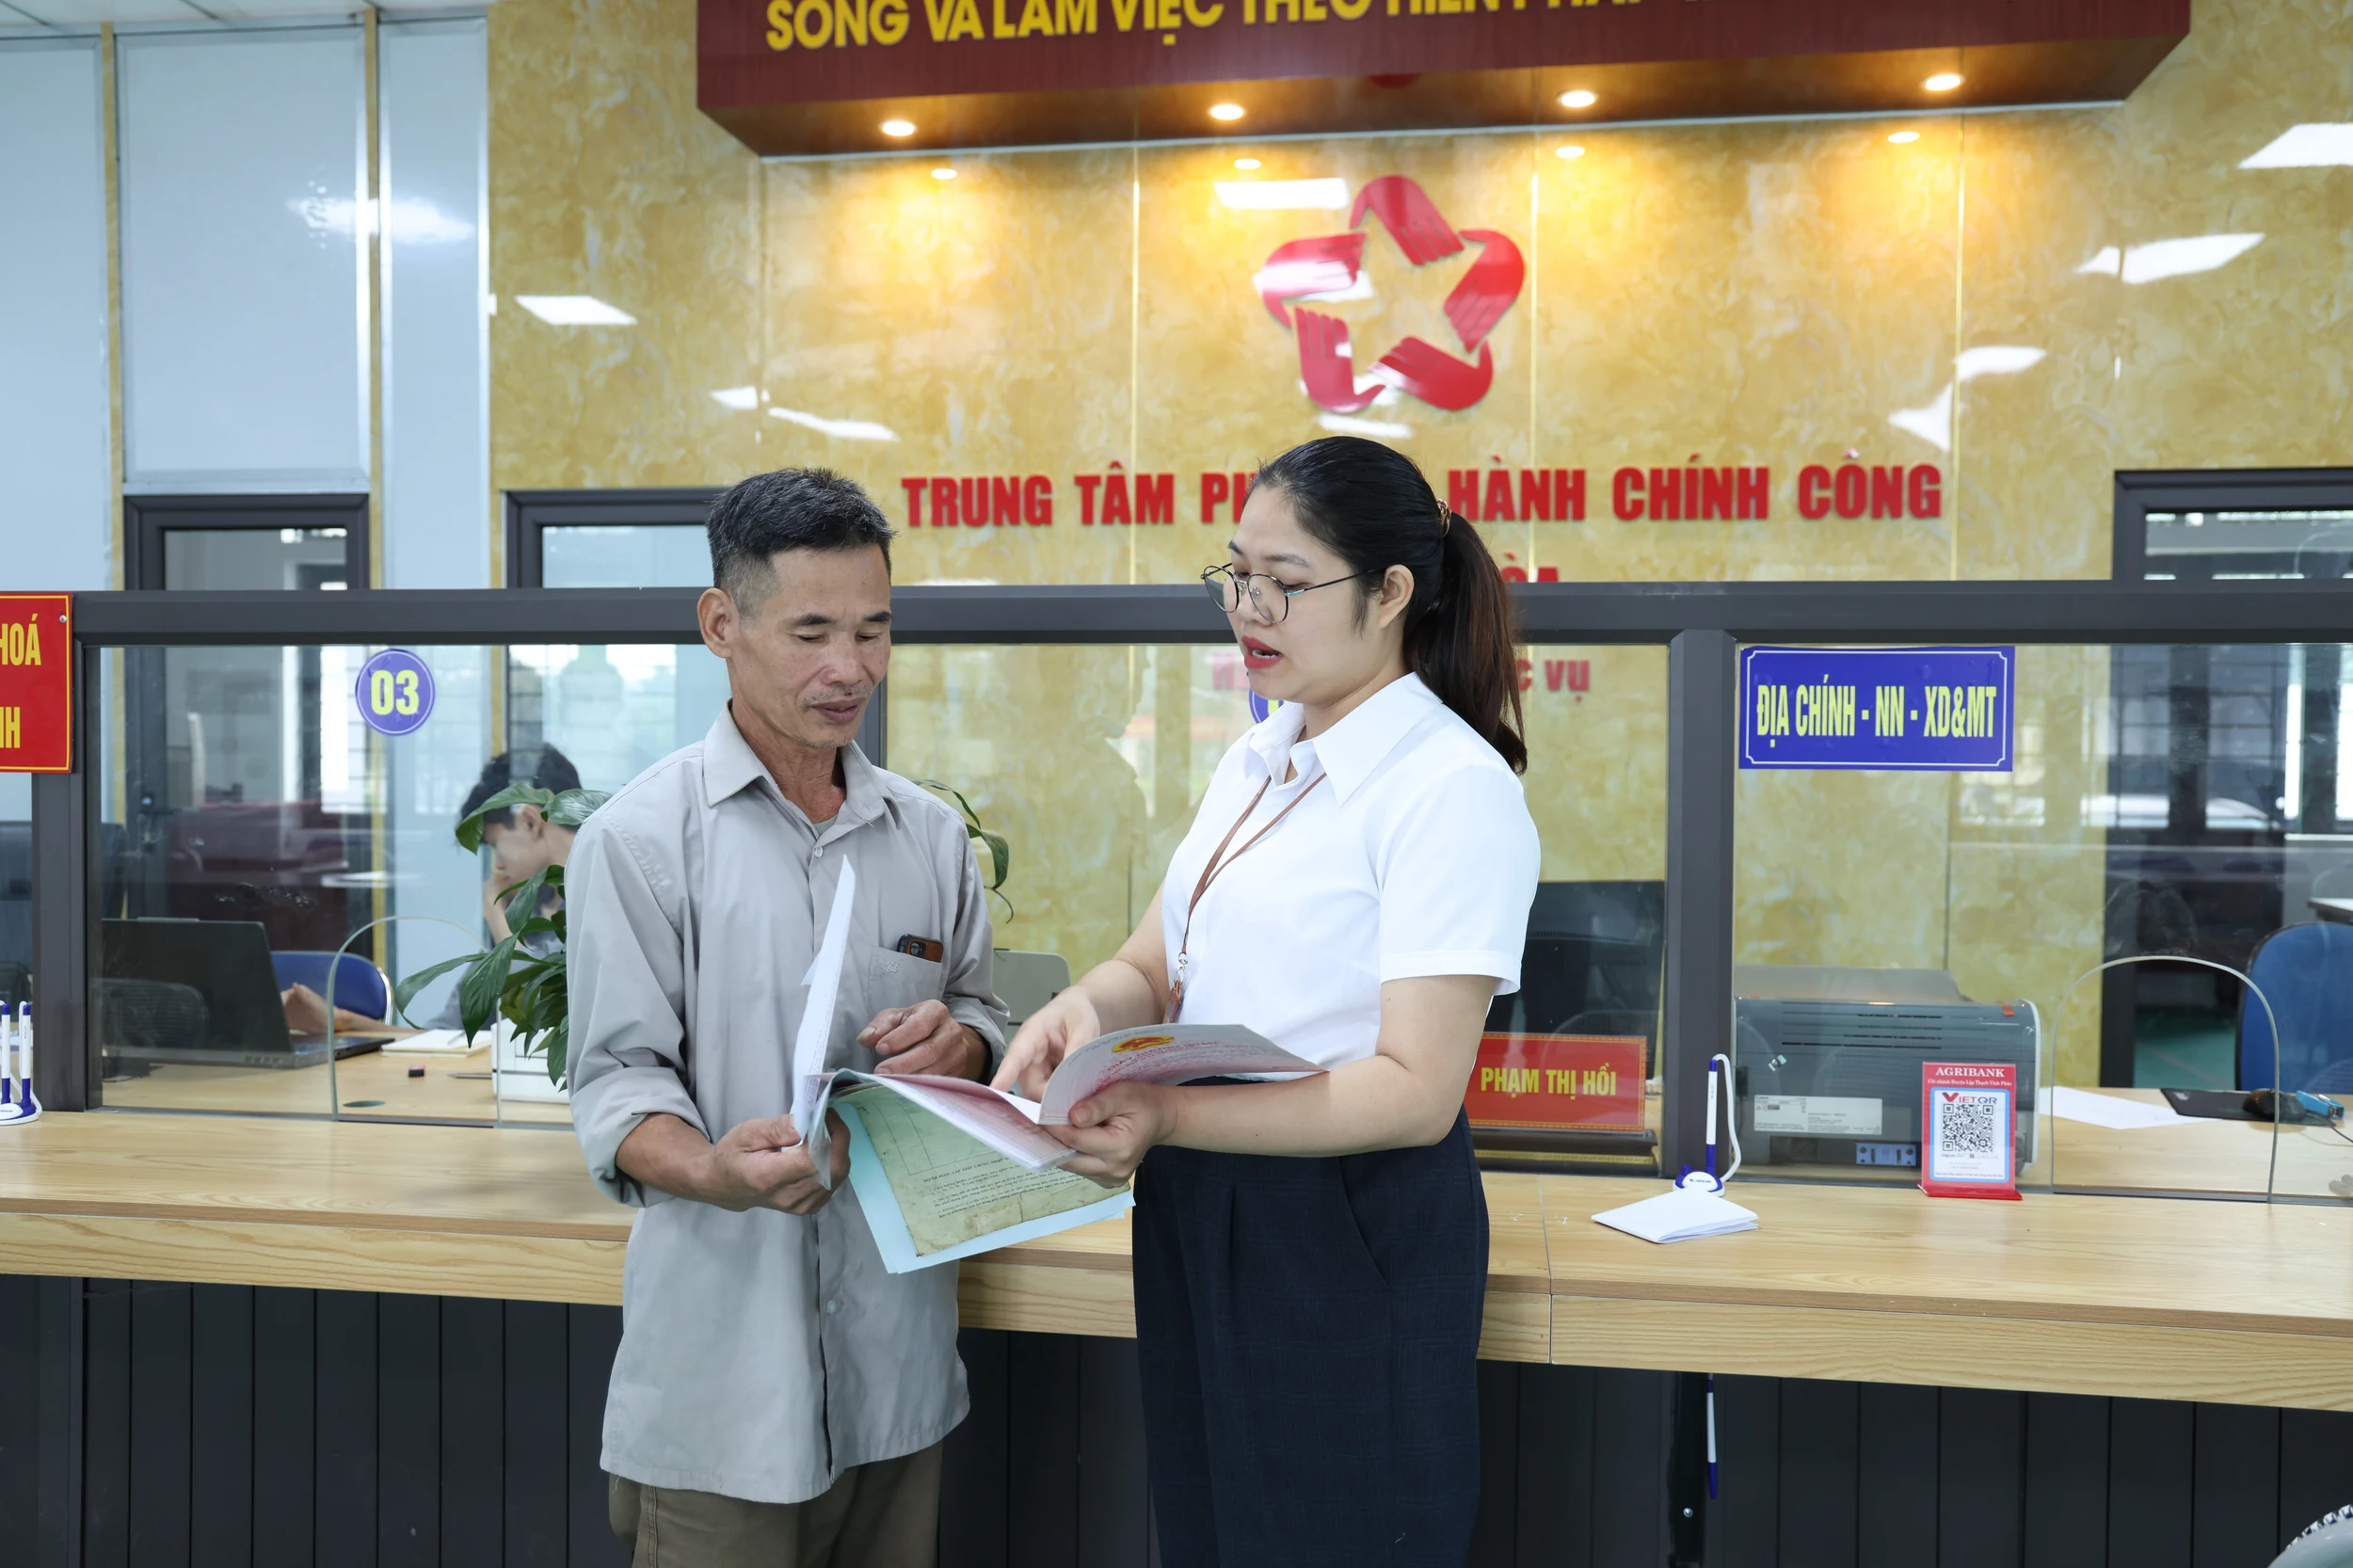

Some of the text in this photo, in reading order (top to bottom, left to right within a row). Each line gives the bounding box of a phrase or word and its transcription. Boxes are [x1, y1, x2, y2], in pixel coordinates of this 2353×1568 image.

[901, 474, 1053, 527] TRUNG
[1074, 460, 1175, 525] TÂM
[1447, 455, 1587, 522] HÀNH
[1611, 452, 1770, 522] CHÍNH
[1797, 447, 1942, 520] CÔNG
[371, 669, 420, 715] 03
[1757, 684, 1789, 748] ĐỊA
[1795, 674, 1856, 737] CHÍNH
[1875, 685, 1905, 737] NN
[1923, 685, 1997, 738] XD&MT
[1481, 1062, 1617, 1100] PHẠM THỊ HỒI
[1935, 1066, 2006, 1078] AGRIBANK
